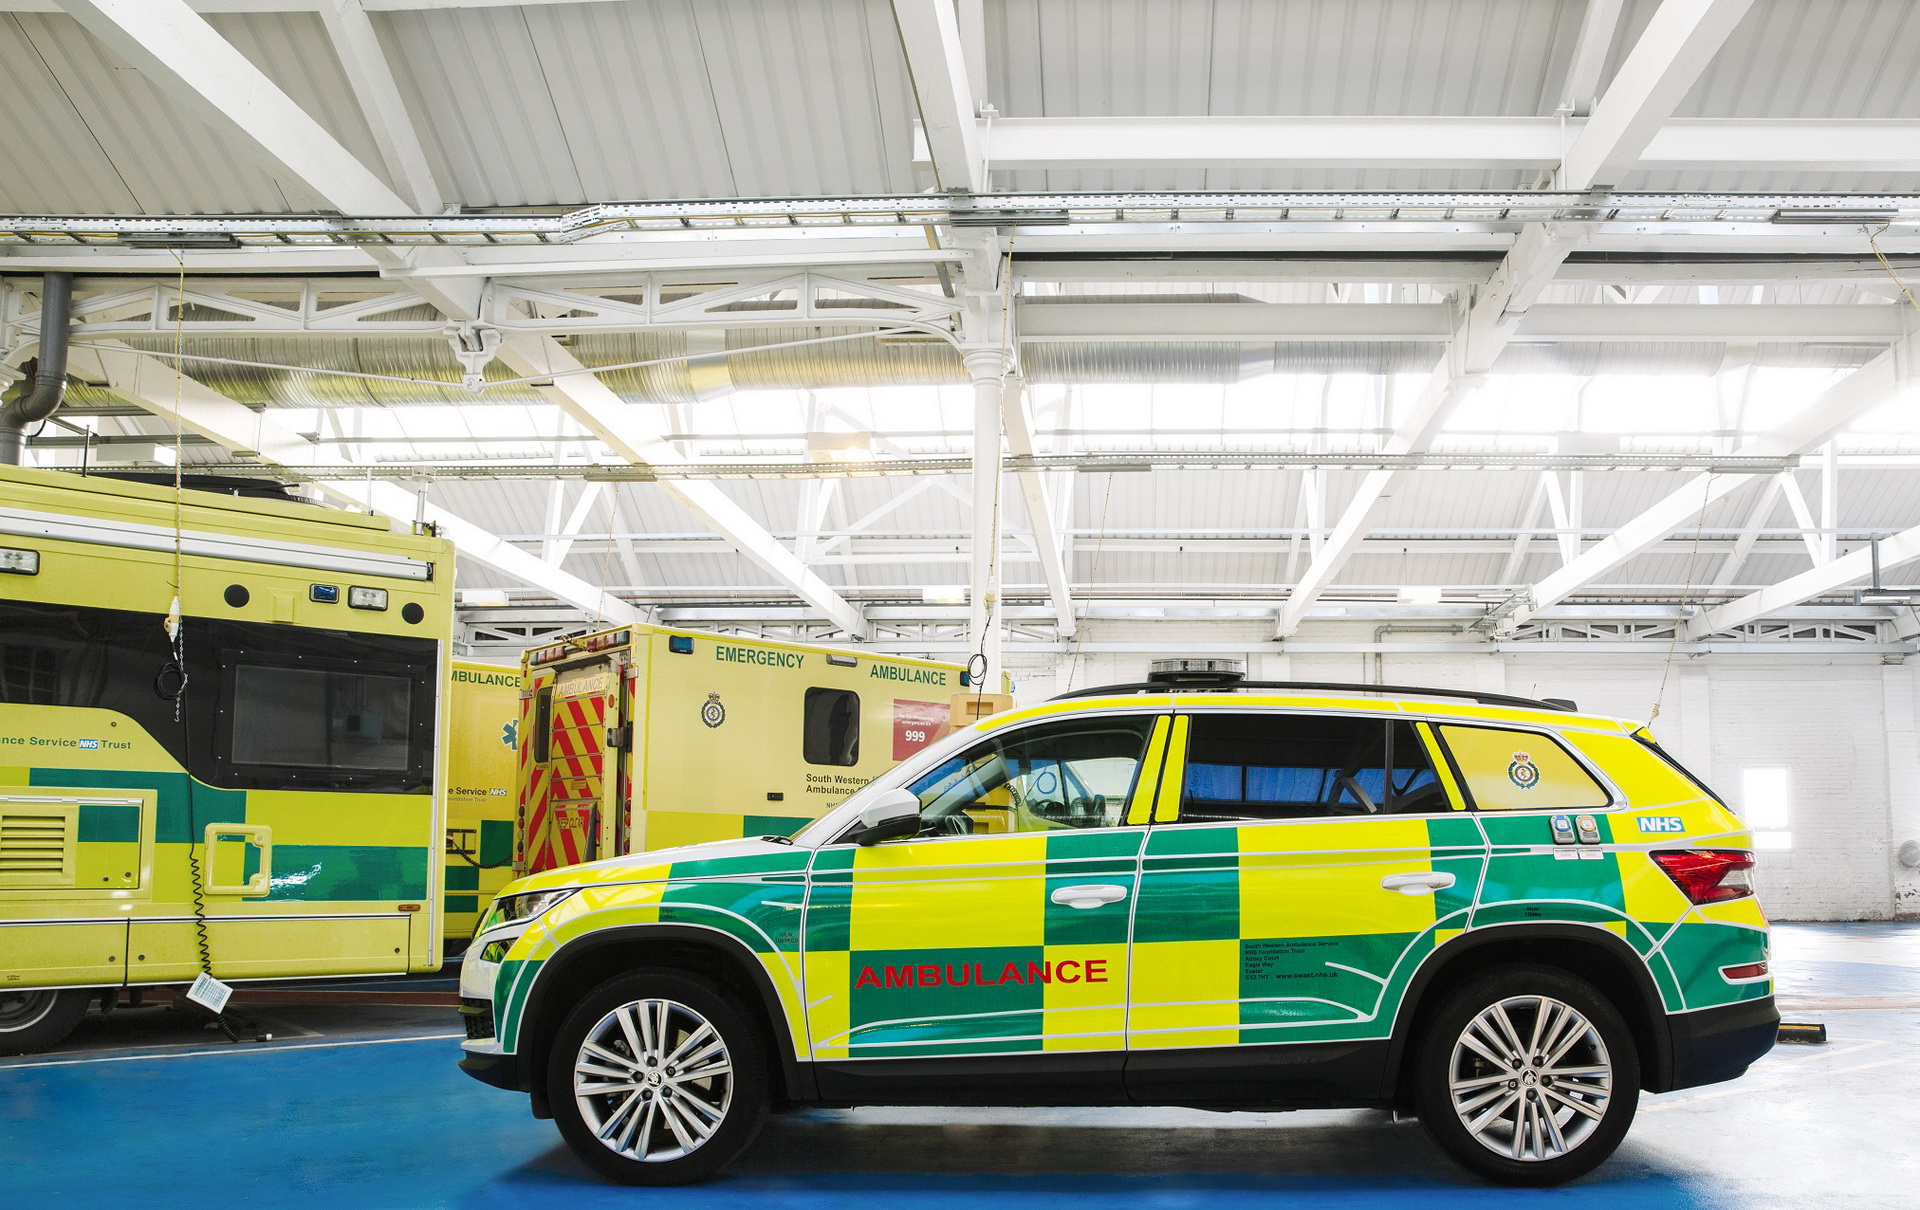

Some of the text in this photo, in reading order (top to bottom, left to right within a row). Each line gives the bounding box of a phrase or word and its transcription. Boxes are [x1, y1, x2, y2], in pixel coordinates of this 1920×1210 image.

[716, 645, 947, 686] EMERGENCY AMBULANCE
[451, 670, 521, 688] MBULANCE
[558, 676, 604, 697] AMBULANCE
[29, 736, 77, 747] Service
[79, 739, 98, 749] NHS
[101, 740, 131, 749] Trust
[905, 730, 925, 742] 999
[805, 773, 869, 785] South Western
[456, 787, 487, 795] Service
[489, 788, 507, 796] NHS
[805, 785, 855, 795] Ambulance
[1638, 817, 1684, 832] NHS
[854, 959, 1109, 989] AMBULANCE
[1275, 971, 1339, 979] www.swast.nhs.uk
